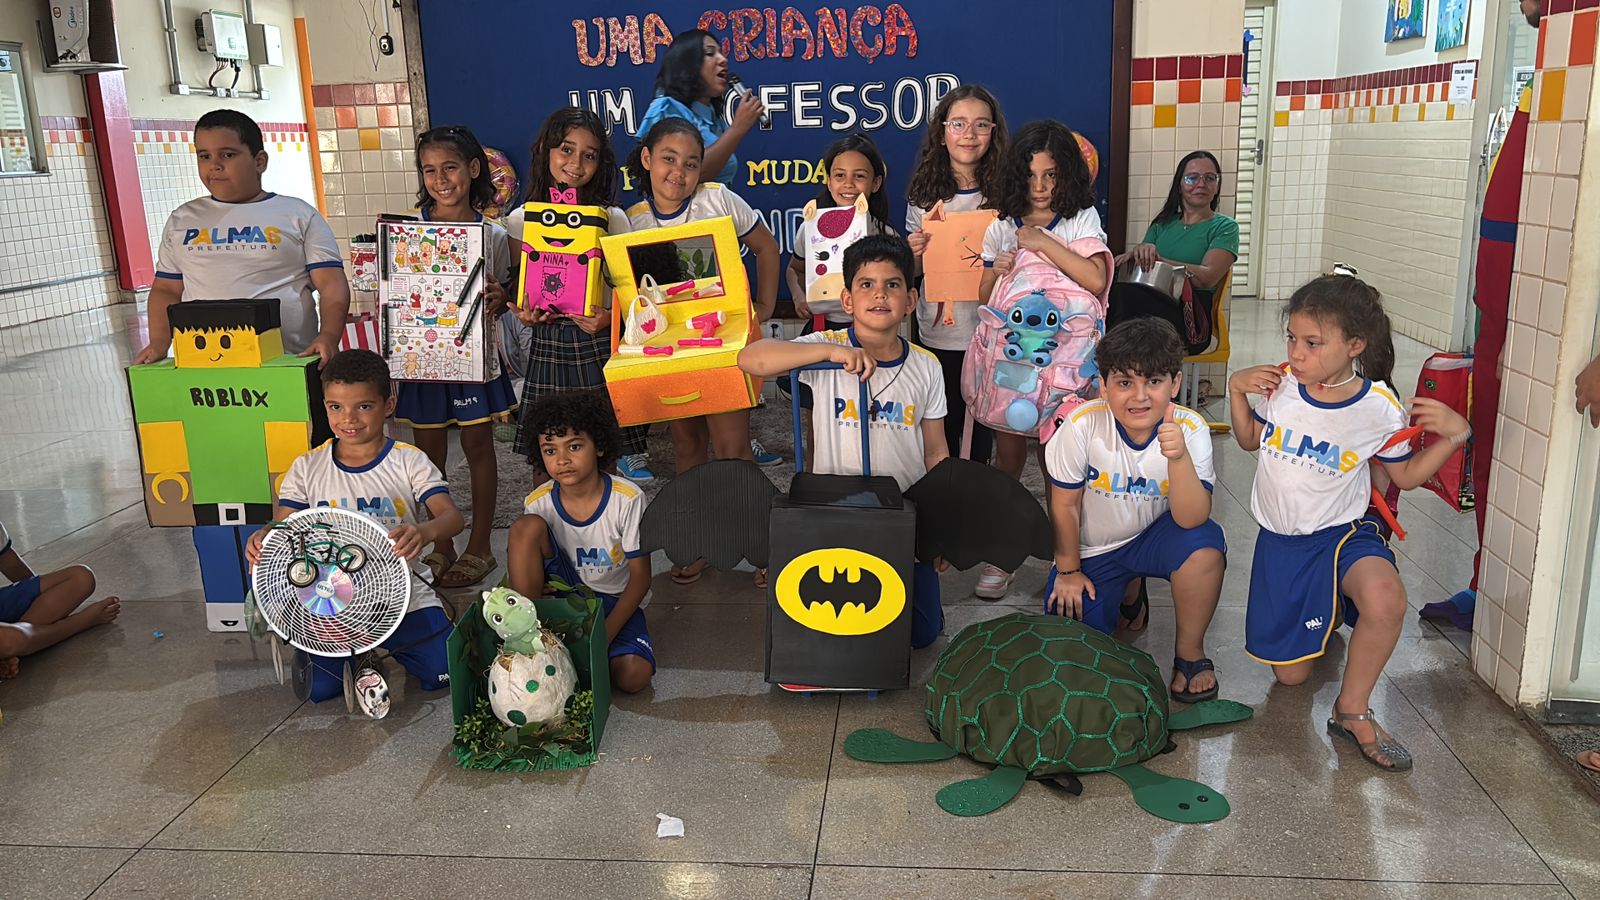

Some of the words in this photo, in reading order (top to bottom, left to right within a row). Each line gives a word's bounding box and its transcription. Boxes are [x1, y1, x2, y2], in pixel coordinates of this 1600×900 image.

[571, 13, 674, 67] UMA
[746, 158, 827, 186] MUDA
[183, 226, 282, 245] PALMAS
[187, 244, 278, 252] PREFEITURA
[543, 253, 564, 266] NINA
[189, 387, 269, 408] ROBLOX
[835, 398, 916, 426] PAMAS
[838, 421, 909, 431] PREEITURA
[1262, 422, 1359, 473] PALMAS
